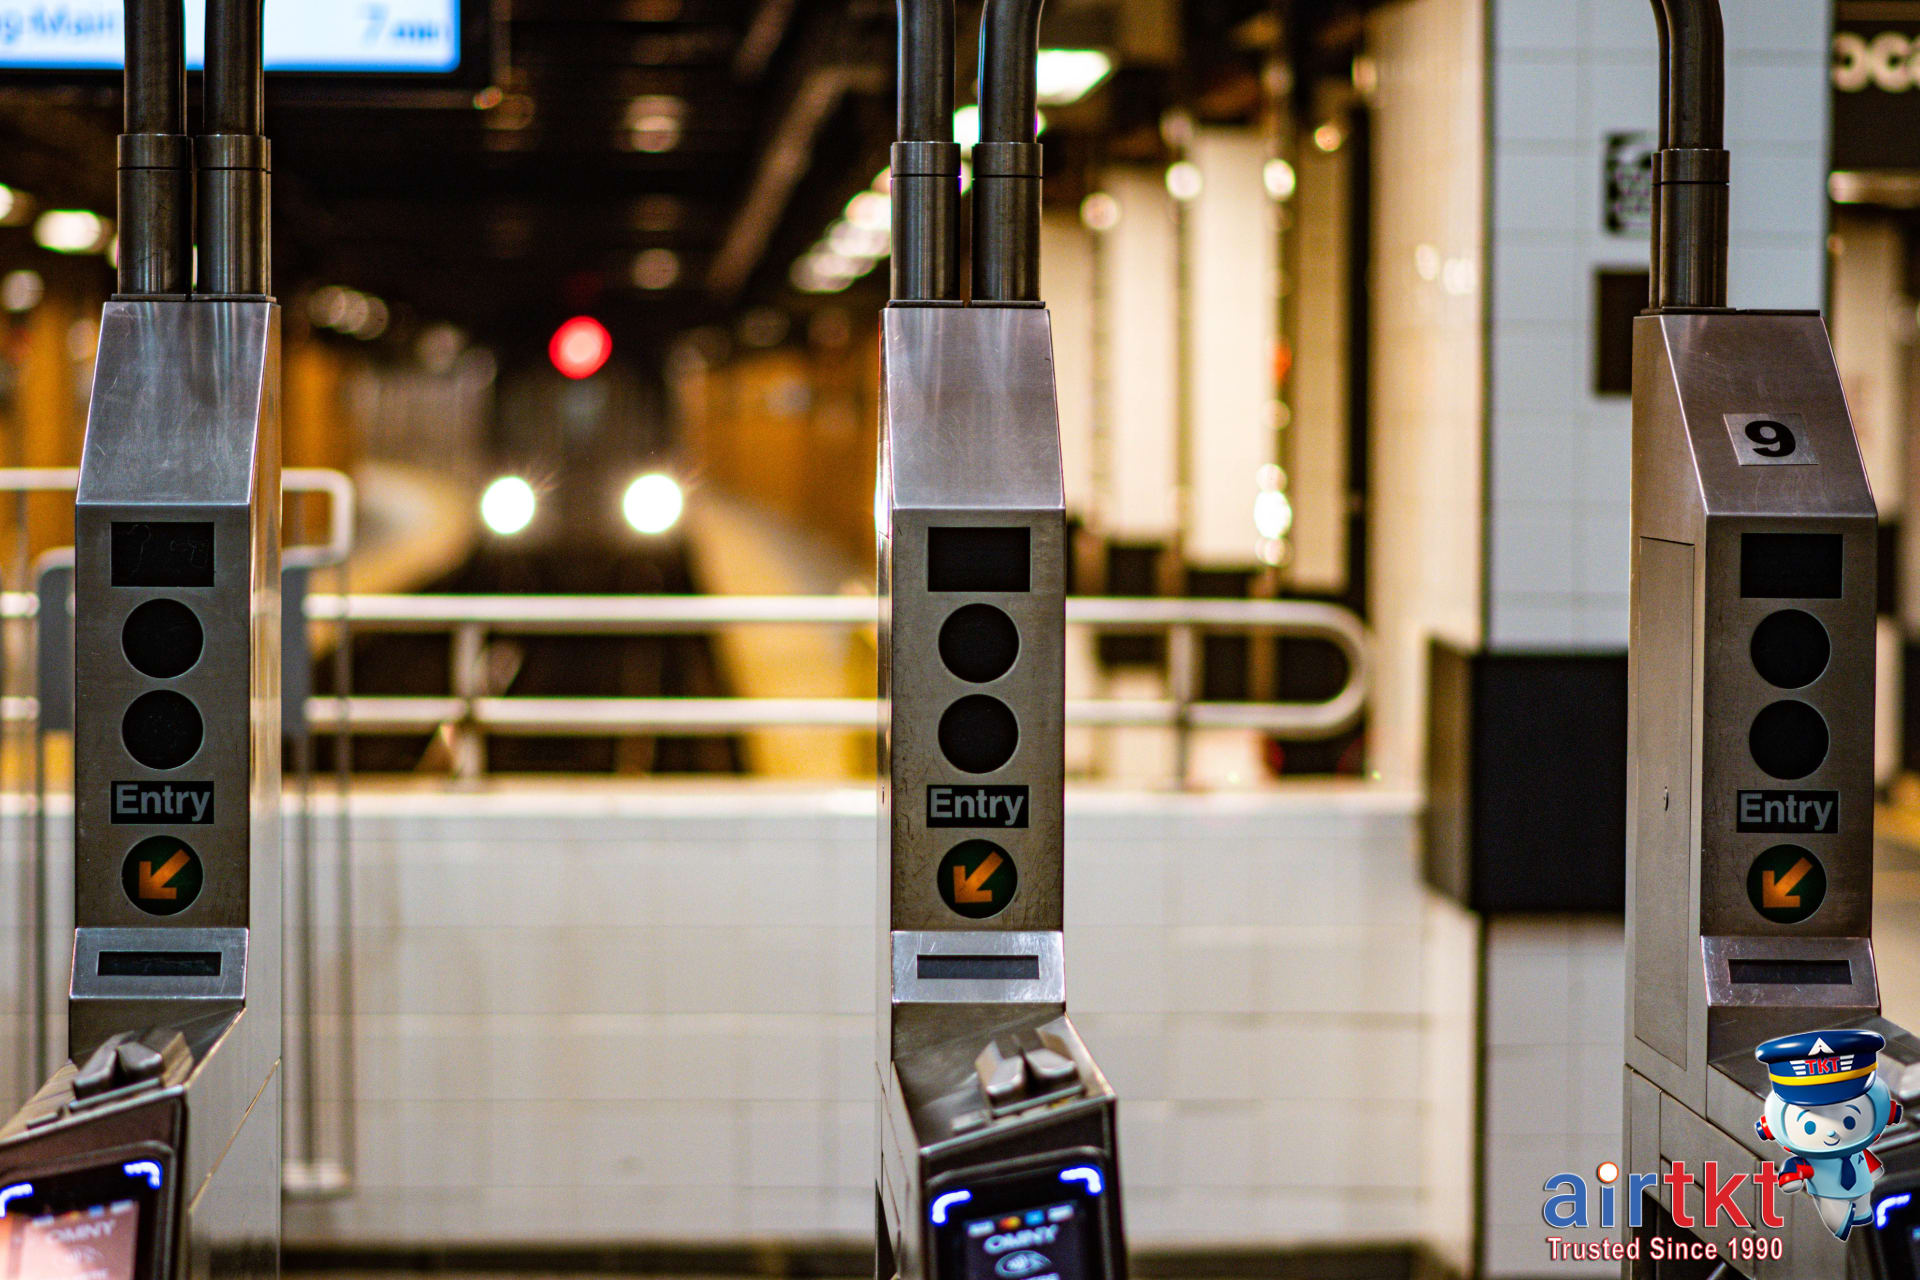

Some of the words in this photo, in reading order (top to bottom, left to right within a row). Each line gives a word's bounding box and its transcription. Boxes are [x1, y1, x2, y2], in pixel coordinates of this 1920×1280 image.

[361, 2, 390, 45] 7
[1745, 420, 1796, 457] 9
[116, 783, 211, 822] Entry
[930, 788, 1024, 826] Entry
[1740, 792, 1833, 831] Entry
[983, 1223, 1060, 1254] OMNY
